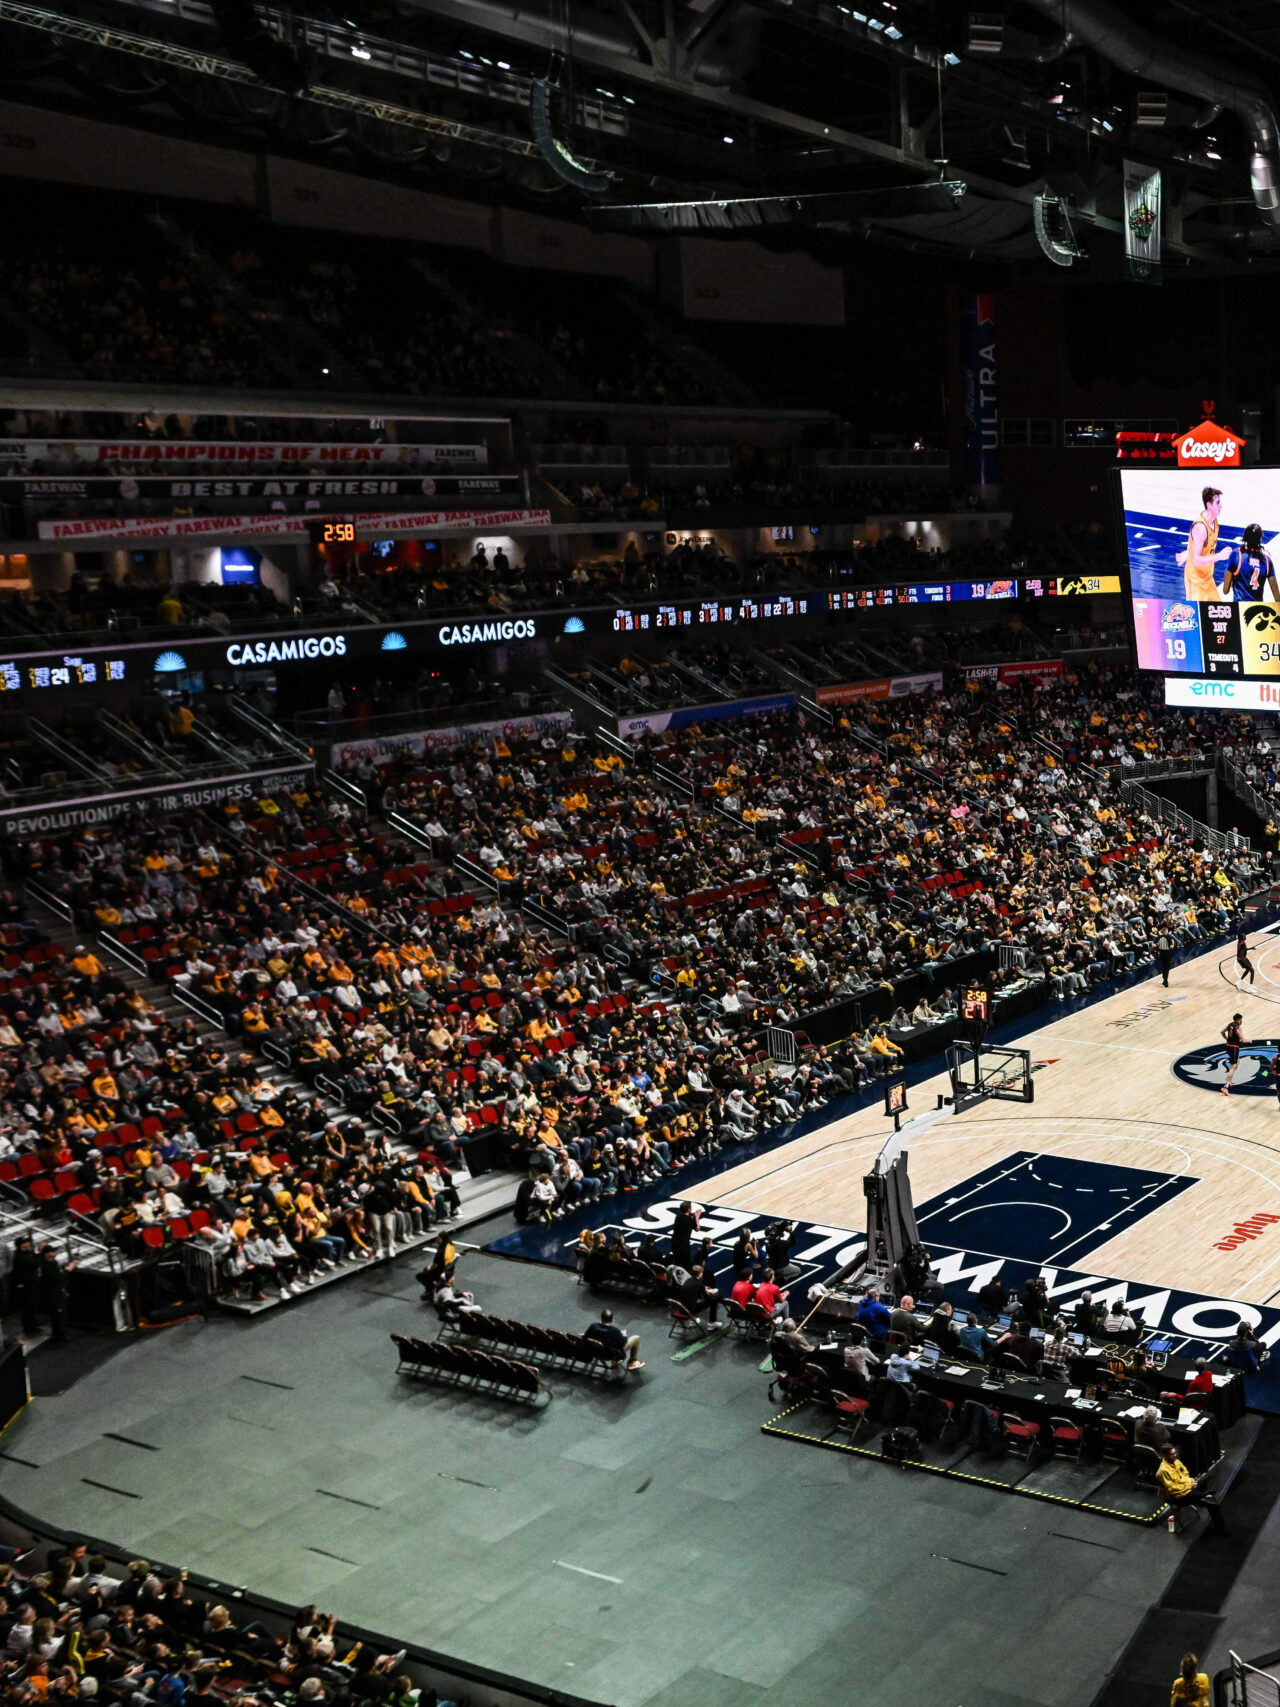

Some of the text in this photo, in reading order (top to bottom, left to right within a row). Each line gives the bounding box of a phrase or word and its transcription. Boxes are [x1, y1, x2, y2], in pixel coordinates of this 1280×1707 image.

[979, 343, 999, 450] ULTRA
[100, 445, 275, 460] CHAMPIONS
[282, 447, 314, 460] OF
[1181, 437, 1236, 462] Casey's
[24, 481, 88, 493] FAREWAY
[170, 482, 253, 497] BEST
[263, 482, 300, 496] AT
[307, 481, 399, 496] FRESH
[53, 519, 127, 538] FAREWAY
[176, 516, 242, 534] FAREWAY
[385, 513, 440, 530] FAREWAY
[473, 510, 525, 528] FAREWAY
[324, 523, 356, 542] 2:58
[971, 584, 984, 598] 19
[1087, 579, 1101, 591] 34
[699, 610, 706, 623] 3
[739, 607, 746, 619] 4
[773, 603, 783, 616] 22
[1207, 605, 1231, 620] 2:58
[613, 618, 621, 631] 0
[656, 614, 664, 627] 2
[438, 619, 537, 646] CASAMIGOS
[1216, 634, 1226, 645] 27
[226, 635, 347, 666] CASAMIGOS
[1165, 637, 1187, 661] 19
[1207, 652, 1239, 665] TIMEOUTS
[1232, 662, 1240, 673] 4
[51, 667, 71, 685] 24
[1188, 680, 1235, 697] emc
[535, 718, 562, 735] LIGHT
[629, 719, 650, 732] emc
[460, 729, 490, 745] LIGHT
[379, 740, 413, 756] LIGHT
[183, 784, 253, 809] BUSINESS
[967, 989, 988, 1003] 2:58
[965, 1001, 987, 1020] 27
